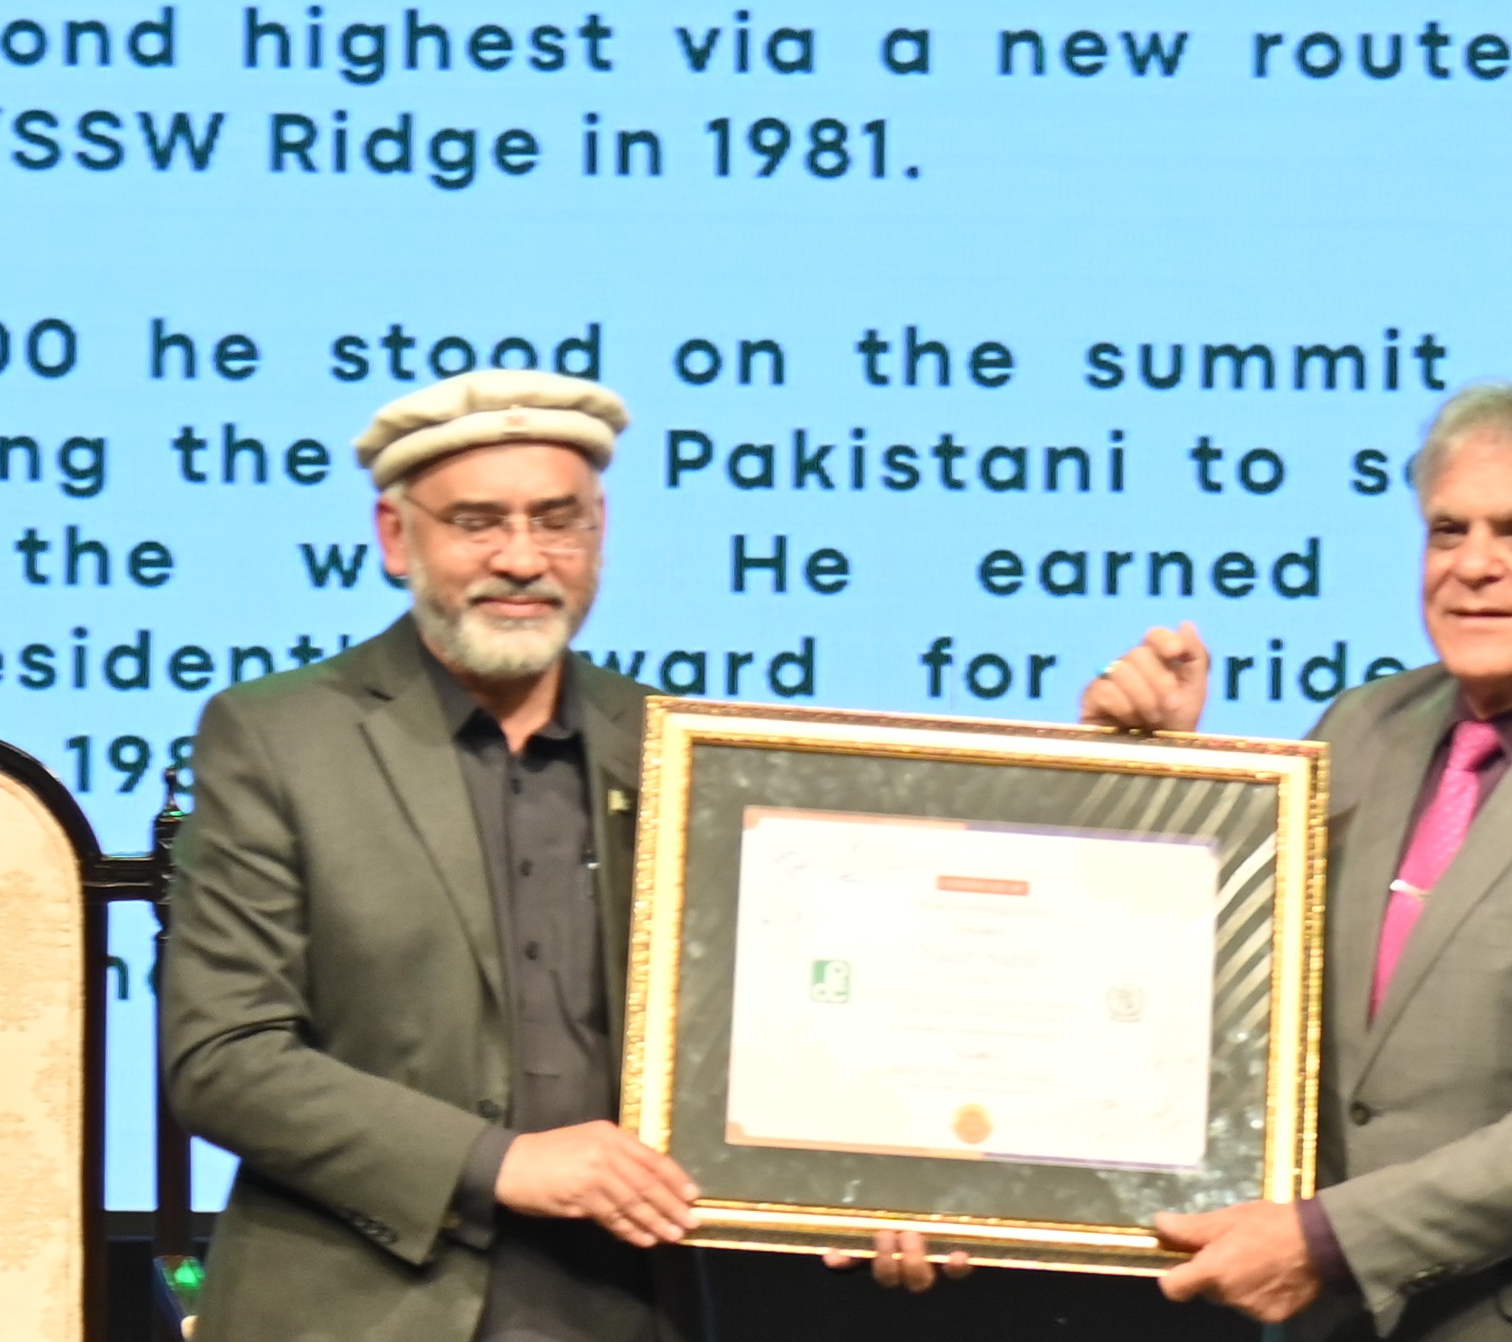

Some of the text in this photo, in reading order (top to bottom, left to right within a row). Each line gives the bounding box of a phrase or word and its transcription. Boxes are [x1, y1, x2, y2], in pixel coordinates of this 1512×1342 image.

[242, 2, 615, 89] highest
[673, 7, 817, 78] via
[878, 26, 932, 78] a
[997, 27, 1191, 80] new
[1251, 19, 1512, 84] route
[268, 107, 542, 194] Ridge
[582, 110, 664, 179] in
[704, 115, 921, 182] 1981.
[148, 316, 262, 384] he
[329, 320, 604, 385] stood
[671, 336, 787, 389] on
[854, 323, 1017, 391] the
[1084, 325, 1449, 394] summit
[169, 420, 333, 489] the
[664, 425, 1126, 495] Pakistani
[1187, 434, 1288, 498] to
[12, 522, 177, 591] the
[729, 532, 853, 598] He
[975, 534, 1323, 602] earned
[588, 634, 818, 701] ward
[918, 634, 1059, 703] for
[1223, 636, 1410, 705] ride
